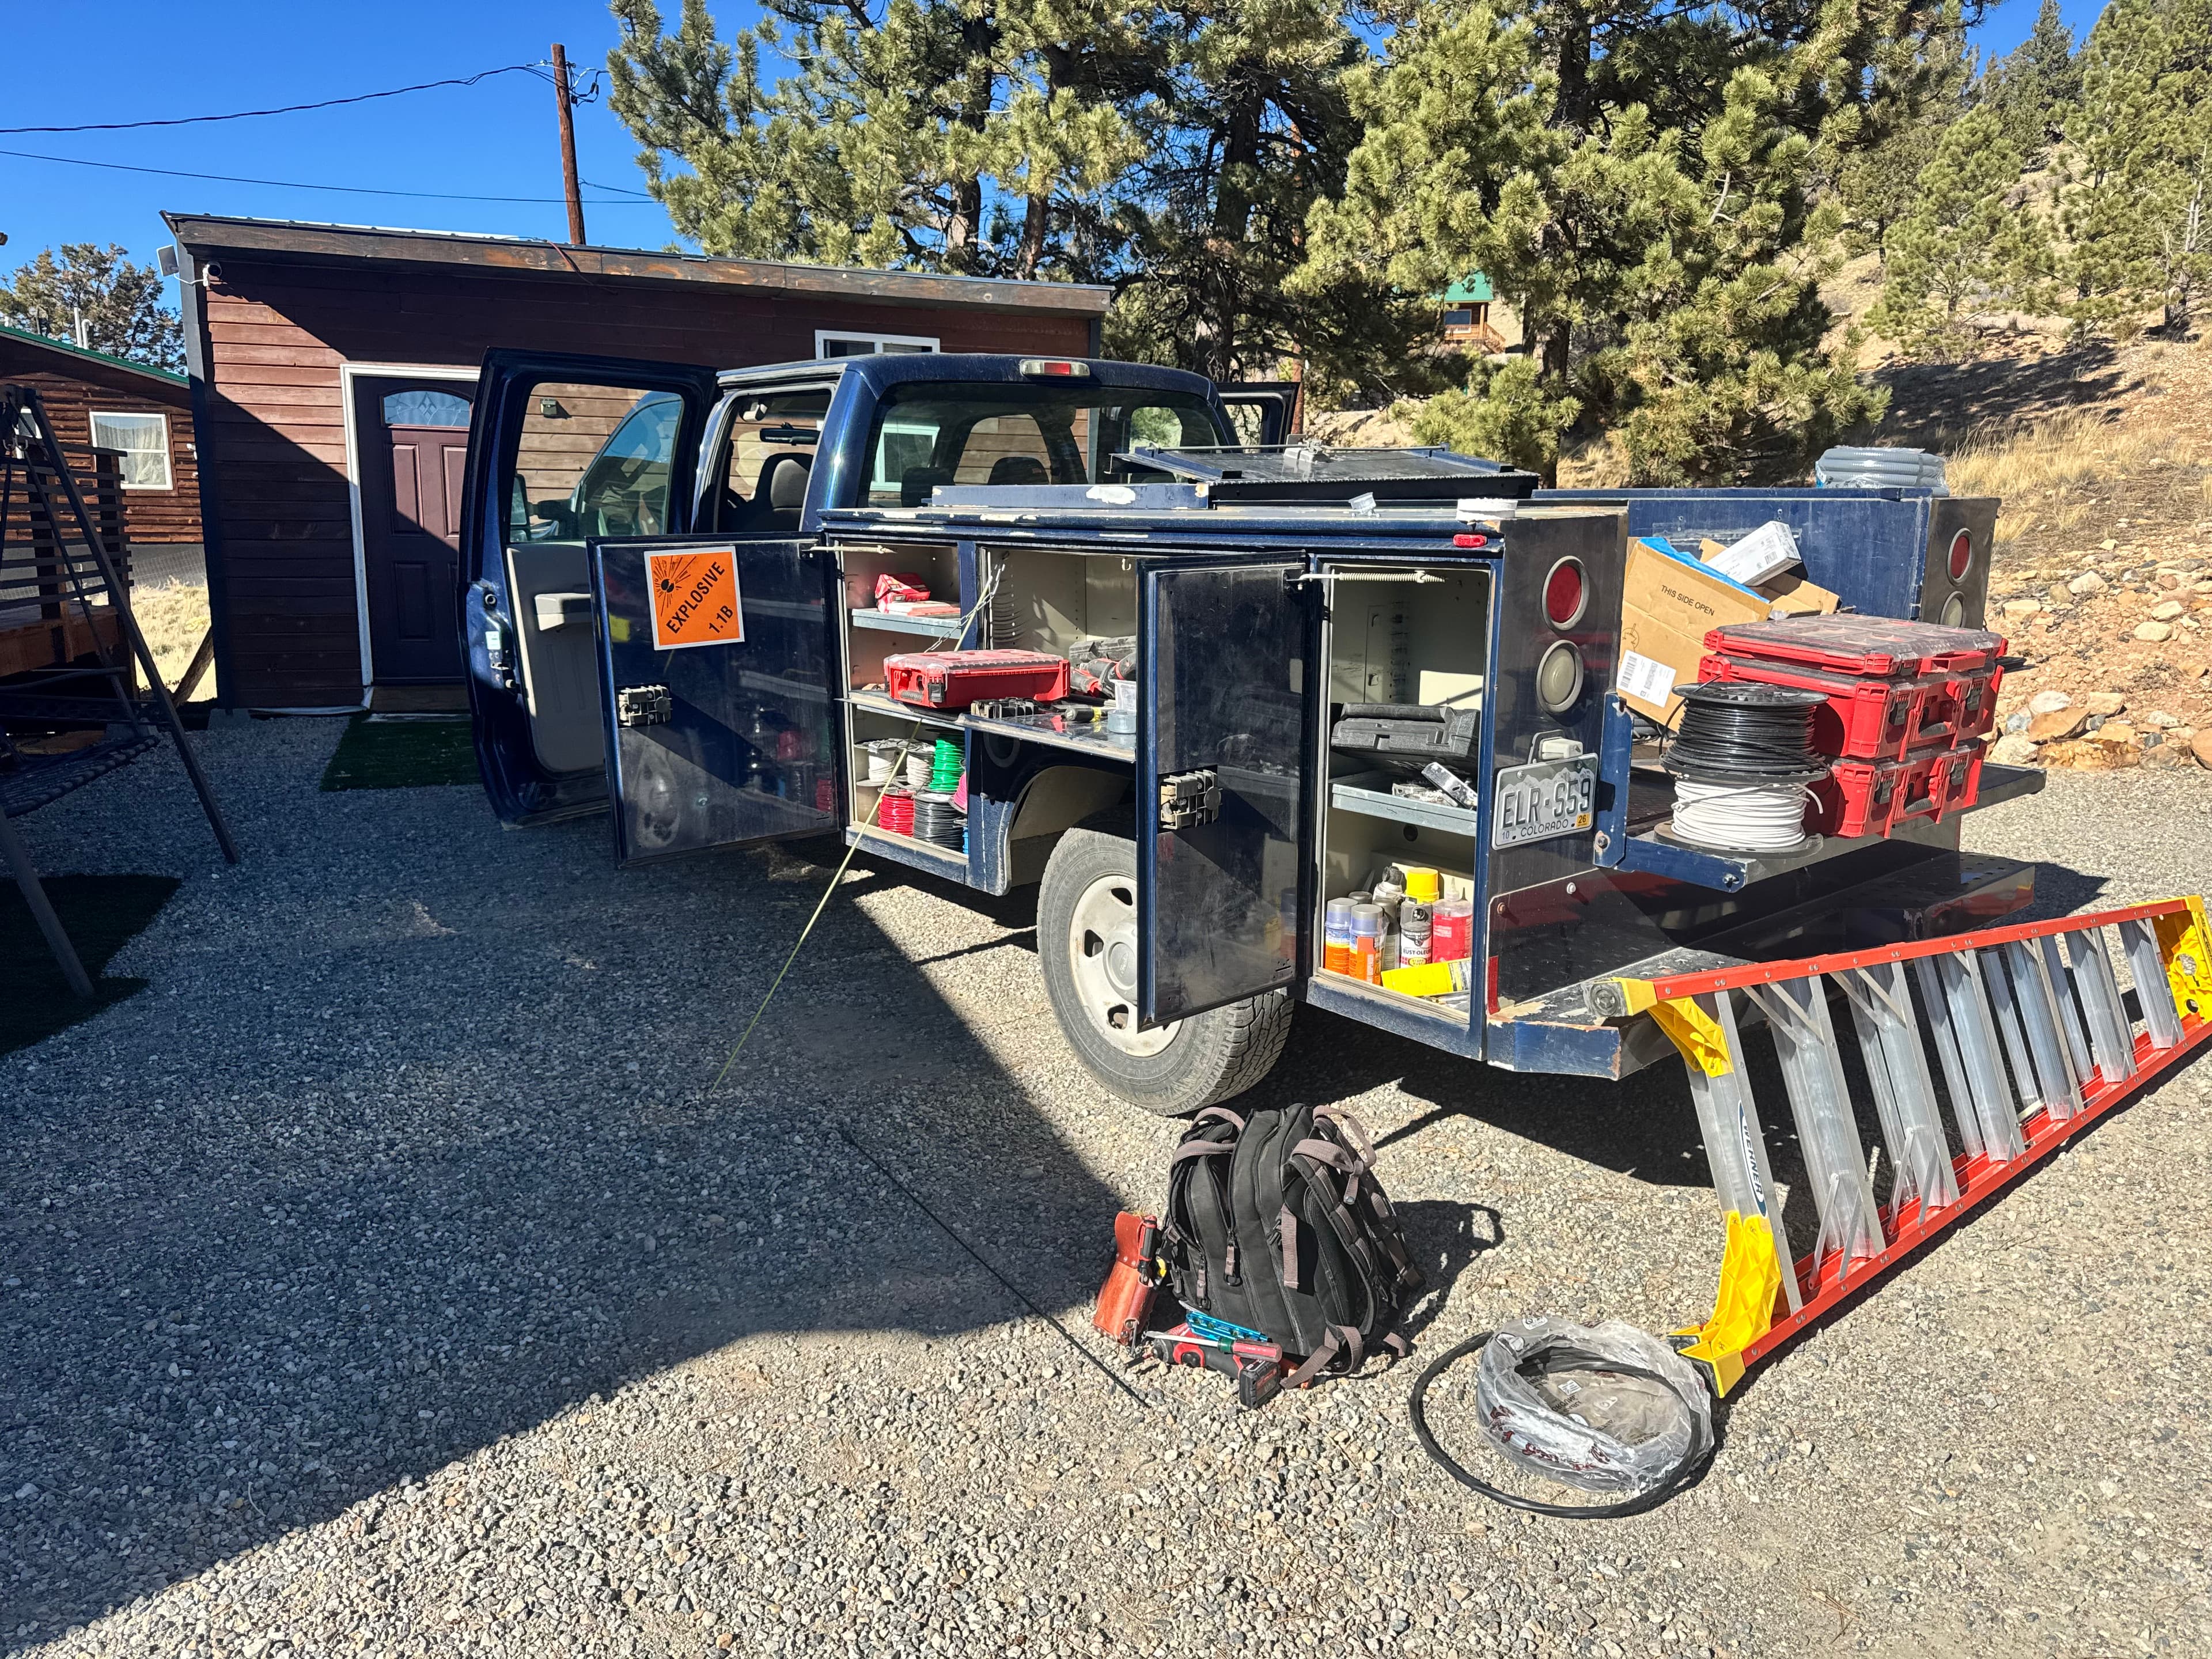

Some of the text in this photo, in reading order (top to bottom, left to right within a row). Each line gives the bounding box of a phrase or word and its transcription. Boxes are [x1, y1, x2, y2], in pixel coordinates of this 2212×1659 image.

[666, 562, 725, 634] EXPLOSIVE
[1661, 585, 1714, 616] THIS SIDE OPEN
[709, 605, 733, 634] 1.1B
[1521, 819, 1568, 837] COLORADO
[1578, 814, 1586, 824] 26
[1502, 831, 1510, 840] 10
[1743, 1125, 1763, 1195] WERNER
